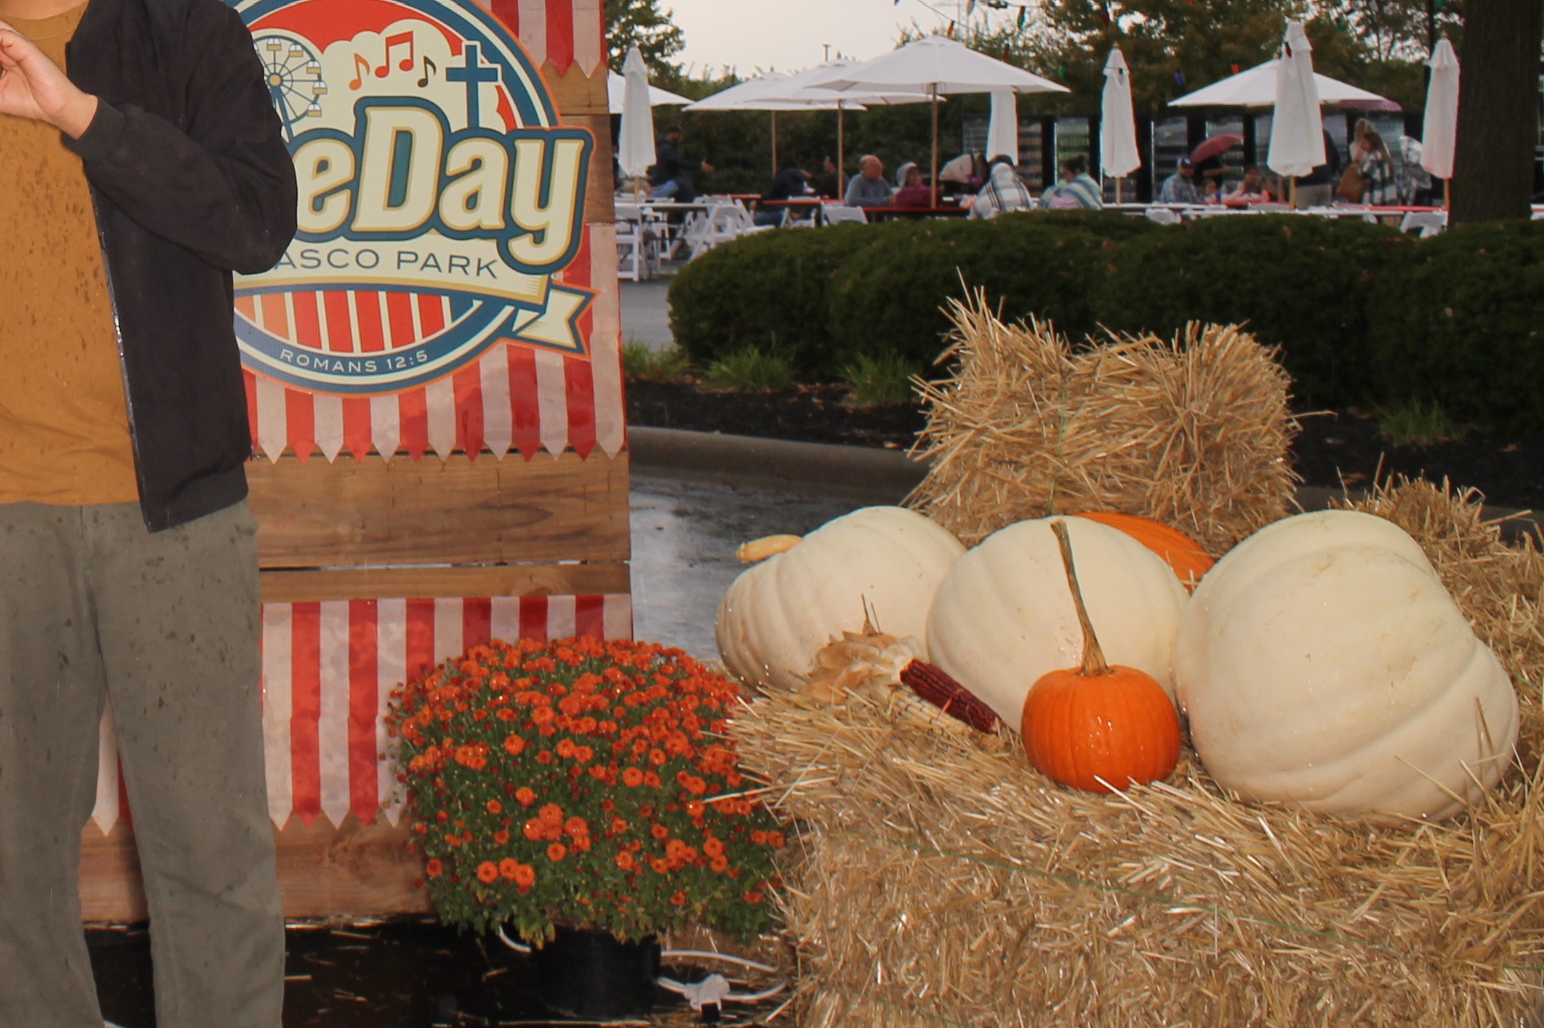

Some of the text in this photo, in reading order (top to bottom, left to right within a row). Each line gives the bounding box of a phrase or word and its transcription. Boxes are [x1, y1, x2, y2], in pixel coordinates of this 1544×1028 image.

[290, 103, 587, 265] eDay
[273, 248, 499, 280] ASCO PARK
[279, 347, 429, 373] ROMANS 12:5
